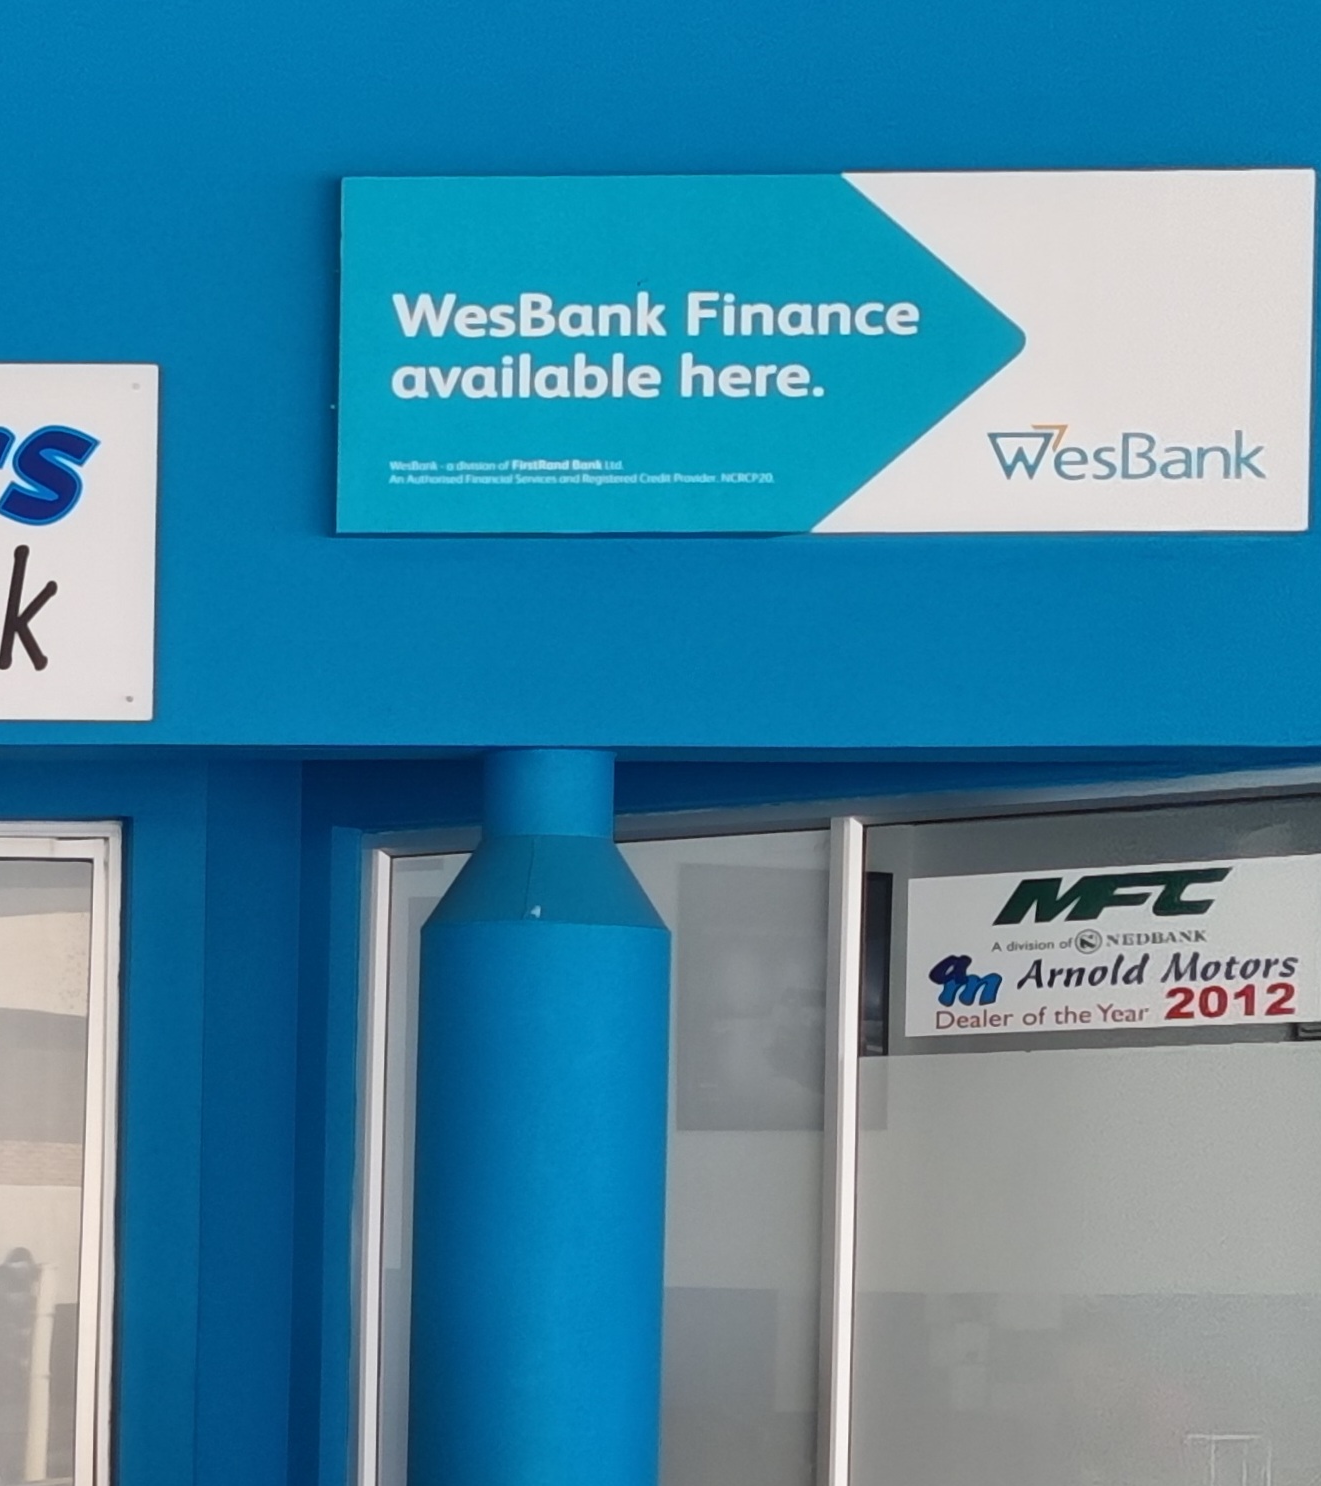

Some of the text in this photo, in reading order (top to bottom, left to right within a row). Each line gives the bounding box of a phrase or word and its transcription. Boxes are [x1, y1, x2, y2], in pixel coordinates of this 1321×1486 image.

[392, 290, 920, 338] WesBank Finance
[392, 352, 825, 399] available here.
[389, 461, 438, 472] WesBank
[511, 459, 570, 471] FirstRand
[572, 459, 602, 470] Bank
[987, 424, 1266, 481] WesBank
[992, 867, 1233, 926] MFC
[991, 929, 1208, 952] A division of NEDBANK
[1017, 954, 1150, 990] Arnold
[1161, 951, 1299, 984] Motors
[936, 982, 1296, 1030] Dealer of the Year 2012
